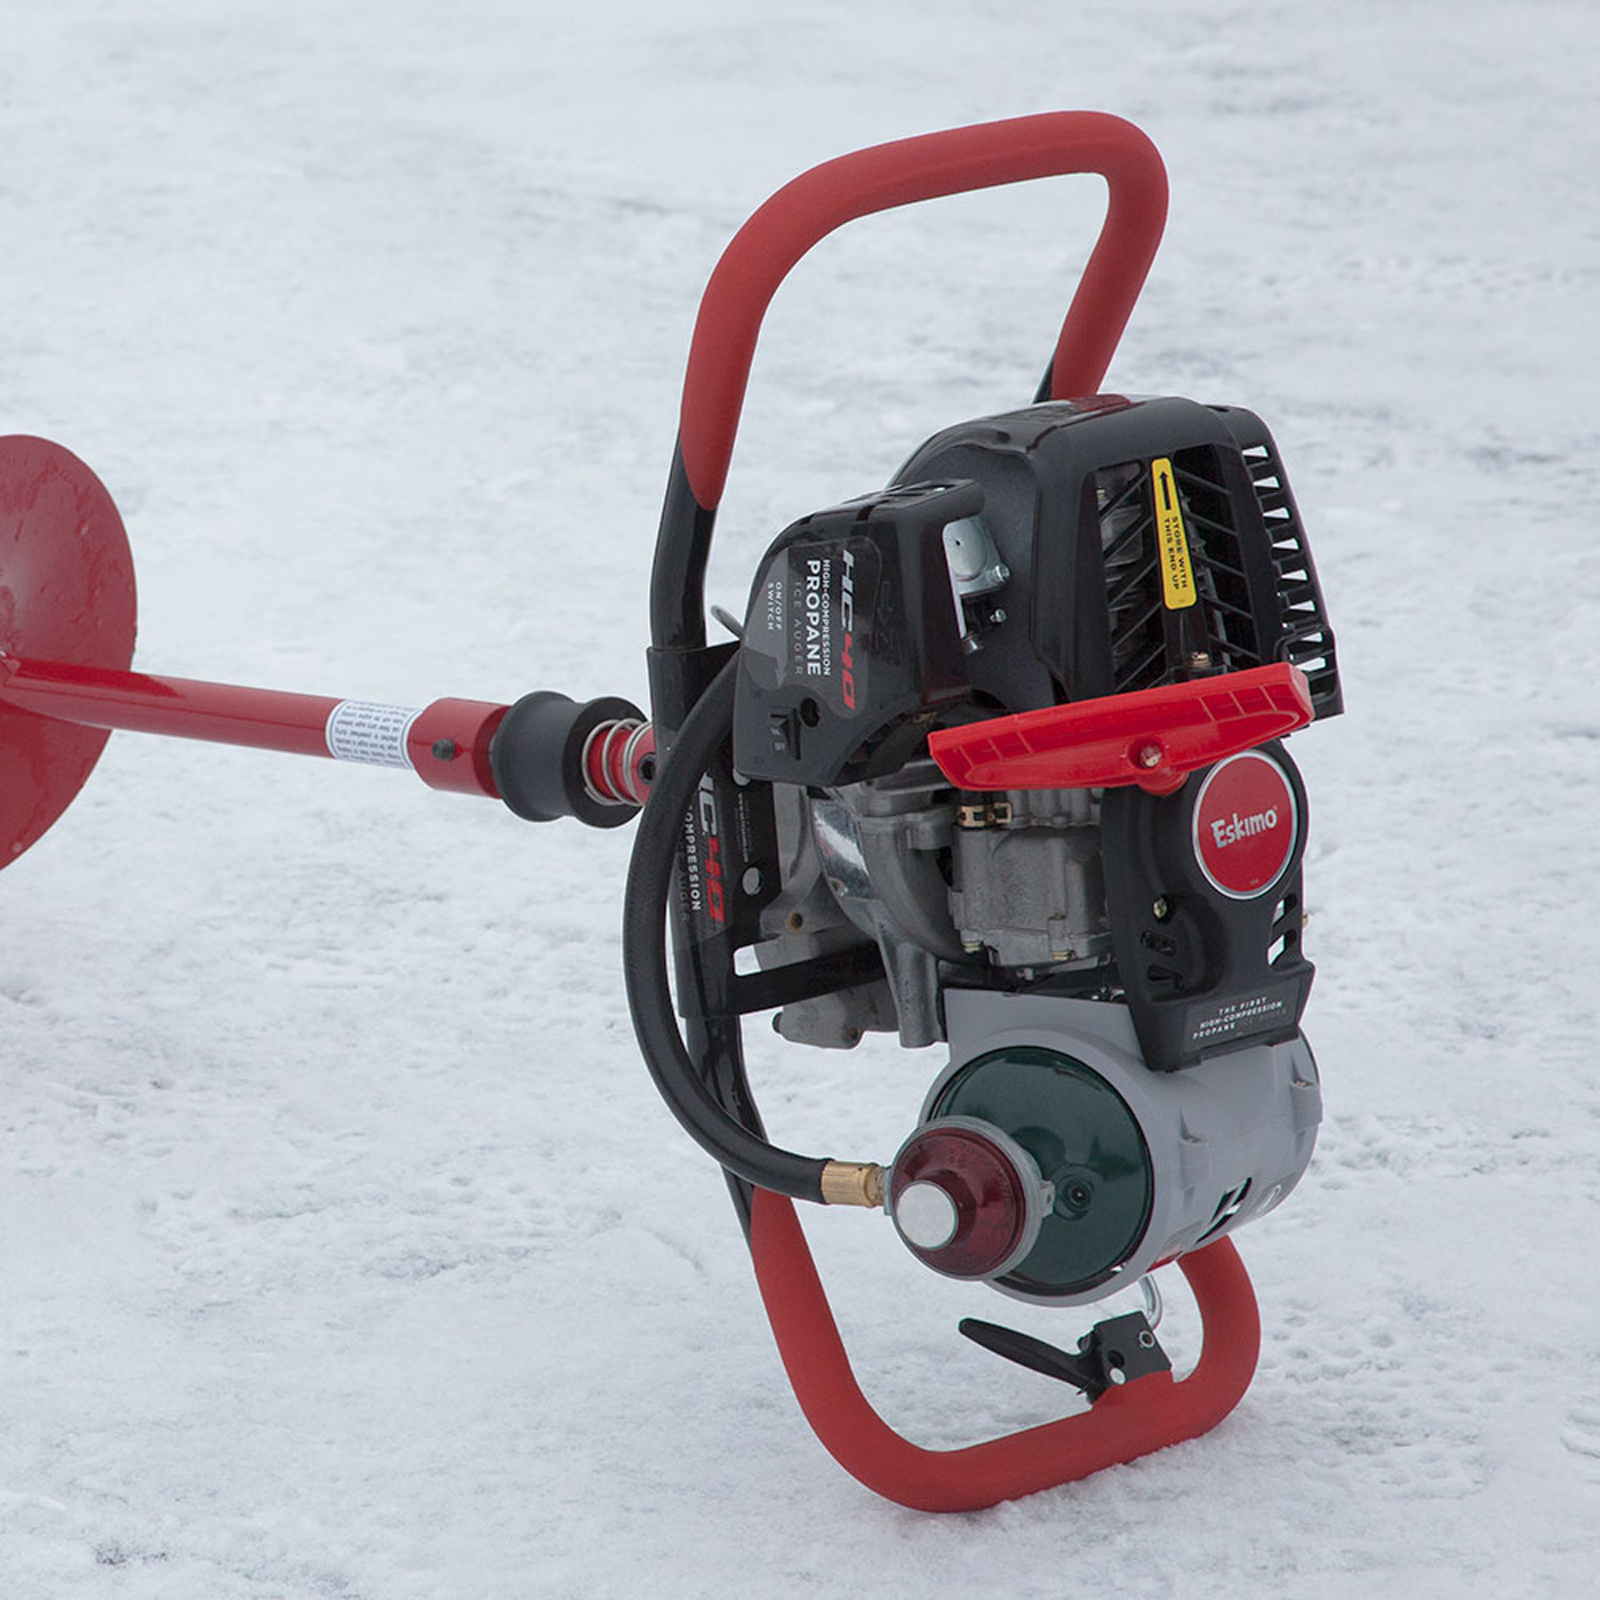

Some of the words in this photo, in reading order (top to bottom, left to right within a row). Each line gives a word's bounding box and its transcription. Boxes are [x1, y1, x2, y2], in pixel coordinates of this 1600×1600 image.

[1164, 517, 1173, 543] THIS
[1168, 547, 1177, 571] END
[1172, 516, 1184, 553] STORE
[1178, 556, 1188, 588] WITH
[793, 581, 802, 609] ICE
[1172, 574, 1179, 589] UP
[805, 559, 821, 675] PROPANE
[821, 559, 831, 676] HIGH-COMPRESSION
[841, 550, 855, 710] HC40
[794, 618, 804, 675] AUGER
[1210, 809, 1277, 848] Eskimo
[1200, 1001, 1282, 1029] HIGH-COMPRESSION
[1219, 1005, 1236, 1016] THE
[1240, 996, 1267, 1010] FIRST
[1193, 1022, 1235, 1039] PROPANE
